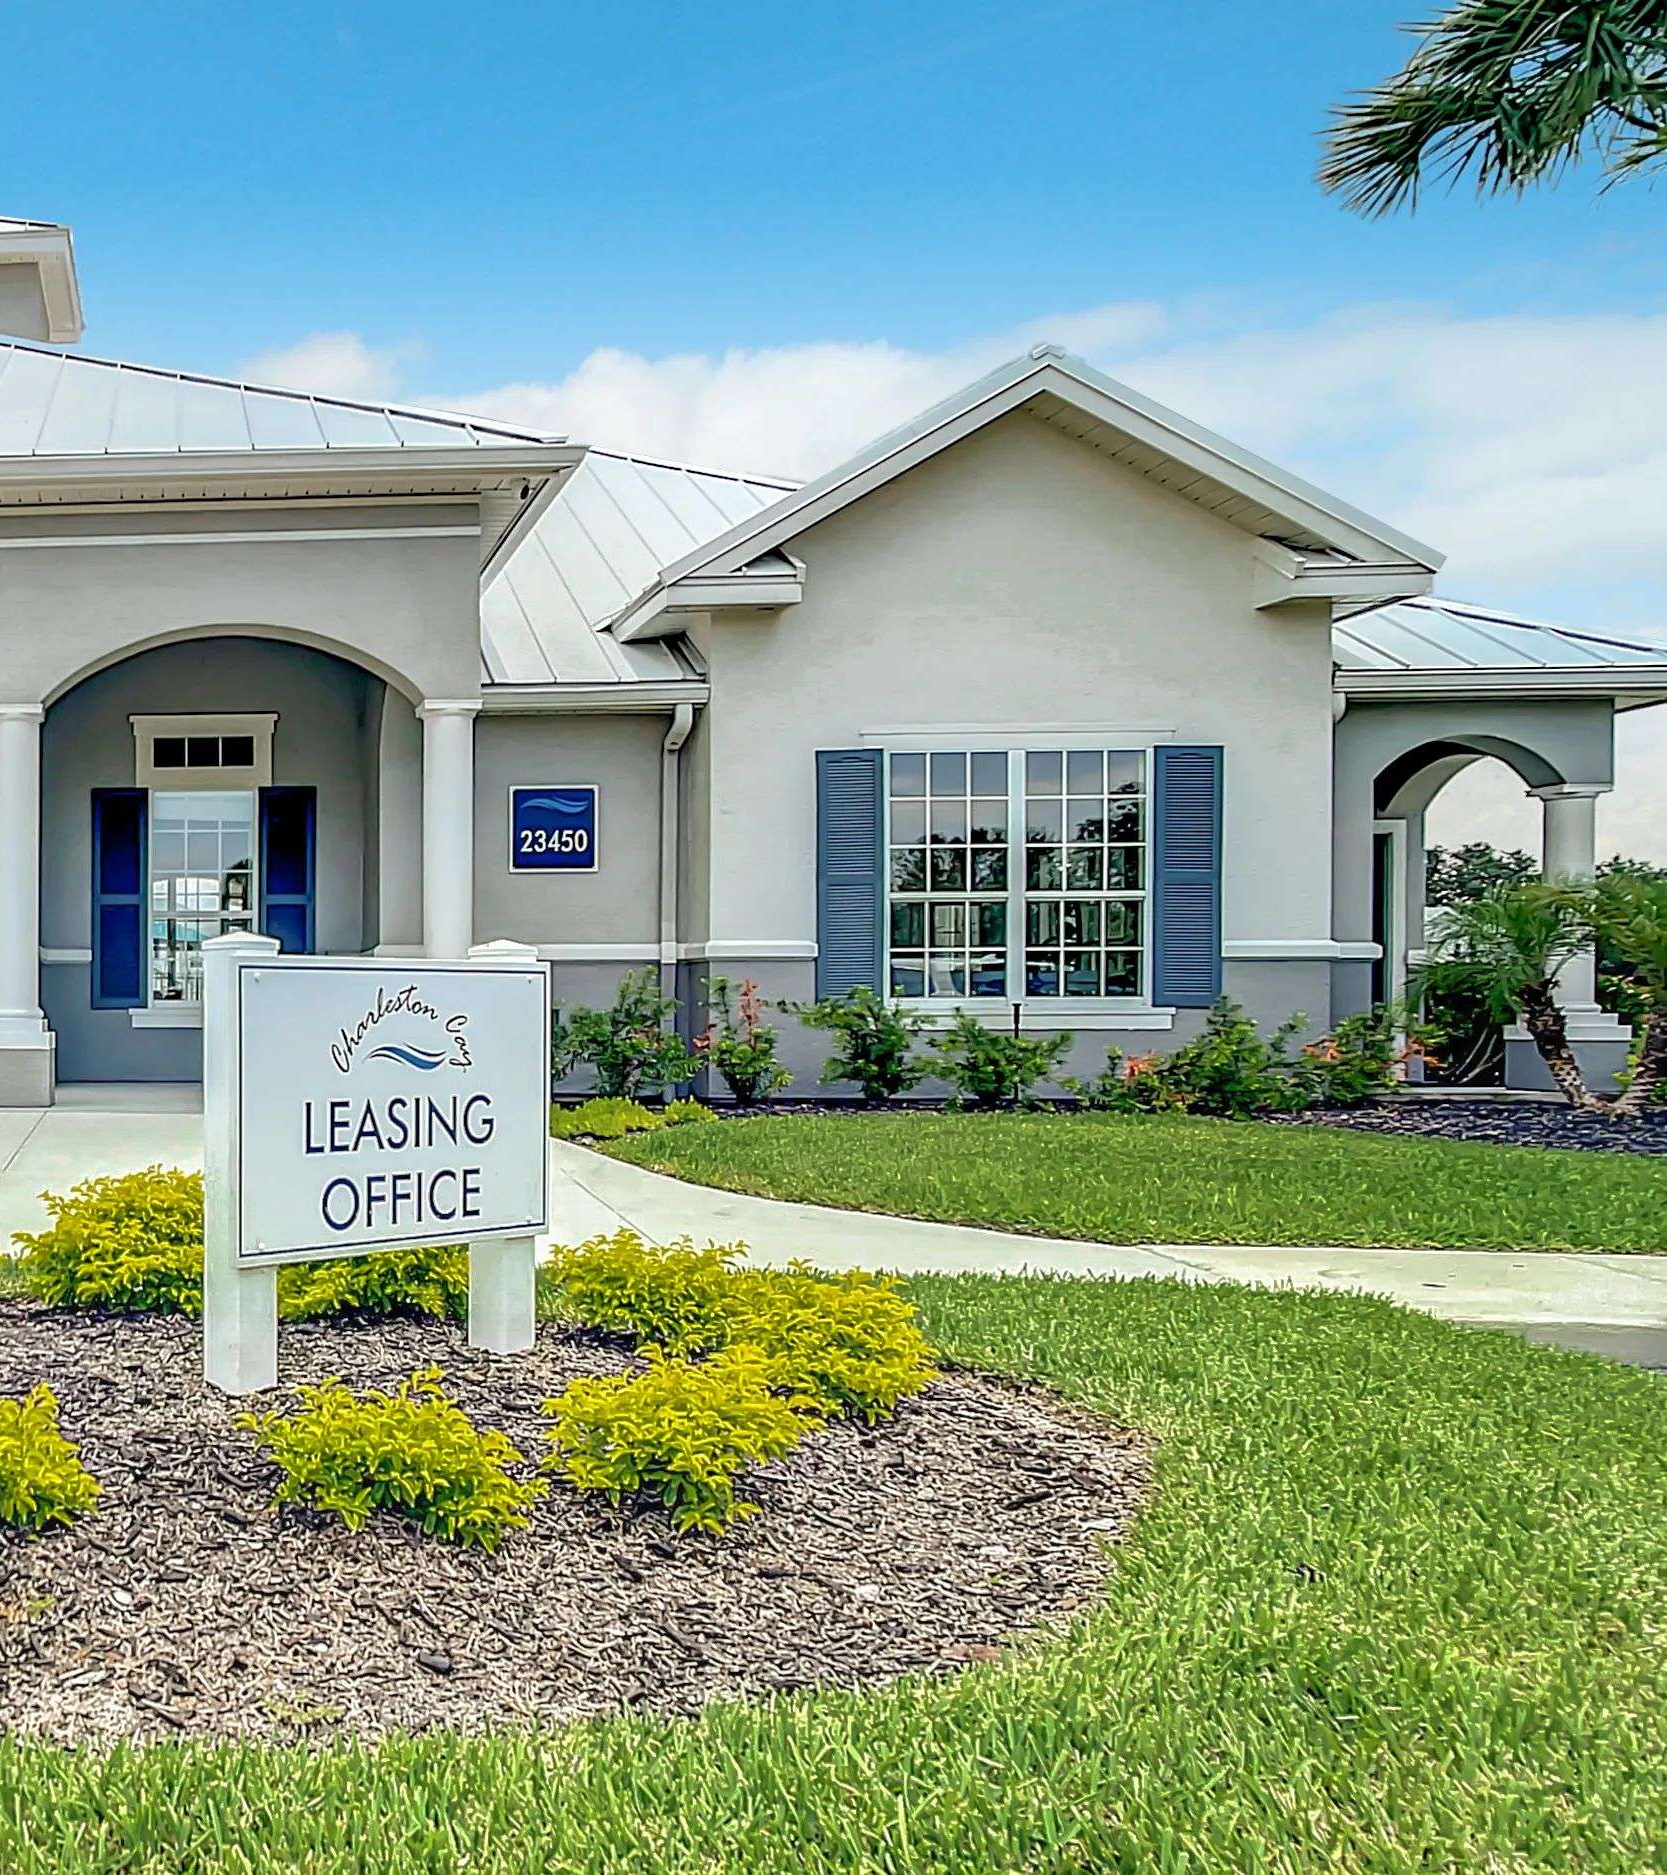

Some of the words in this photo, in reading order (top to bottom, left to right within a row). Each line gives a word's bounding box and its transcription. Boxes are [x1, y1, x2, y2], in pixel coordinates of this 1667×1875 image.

[520, 829, 588, 853] 23450
[332, 985, 439, 1073] Charleston
[445, 1015, 473, 1073] Cay
[304, 1094, 495, 1154] LEASING
[322, 1168, 481, 1230] OFFICE
